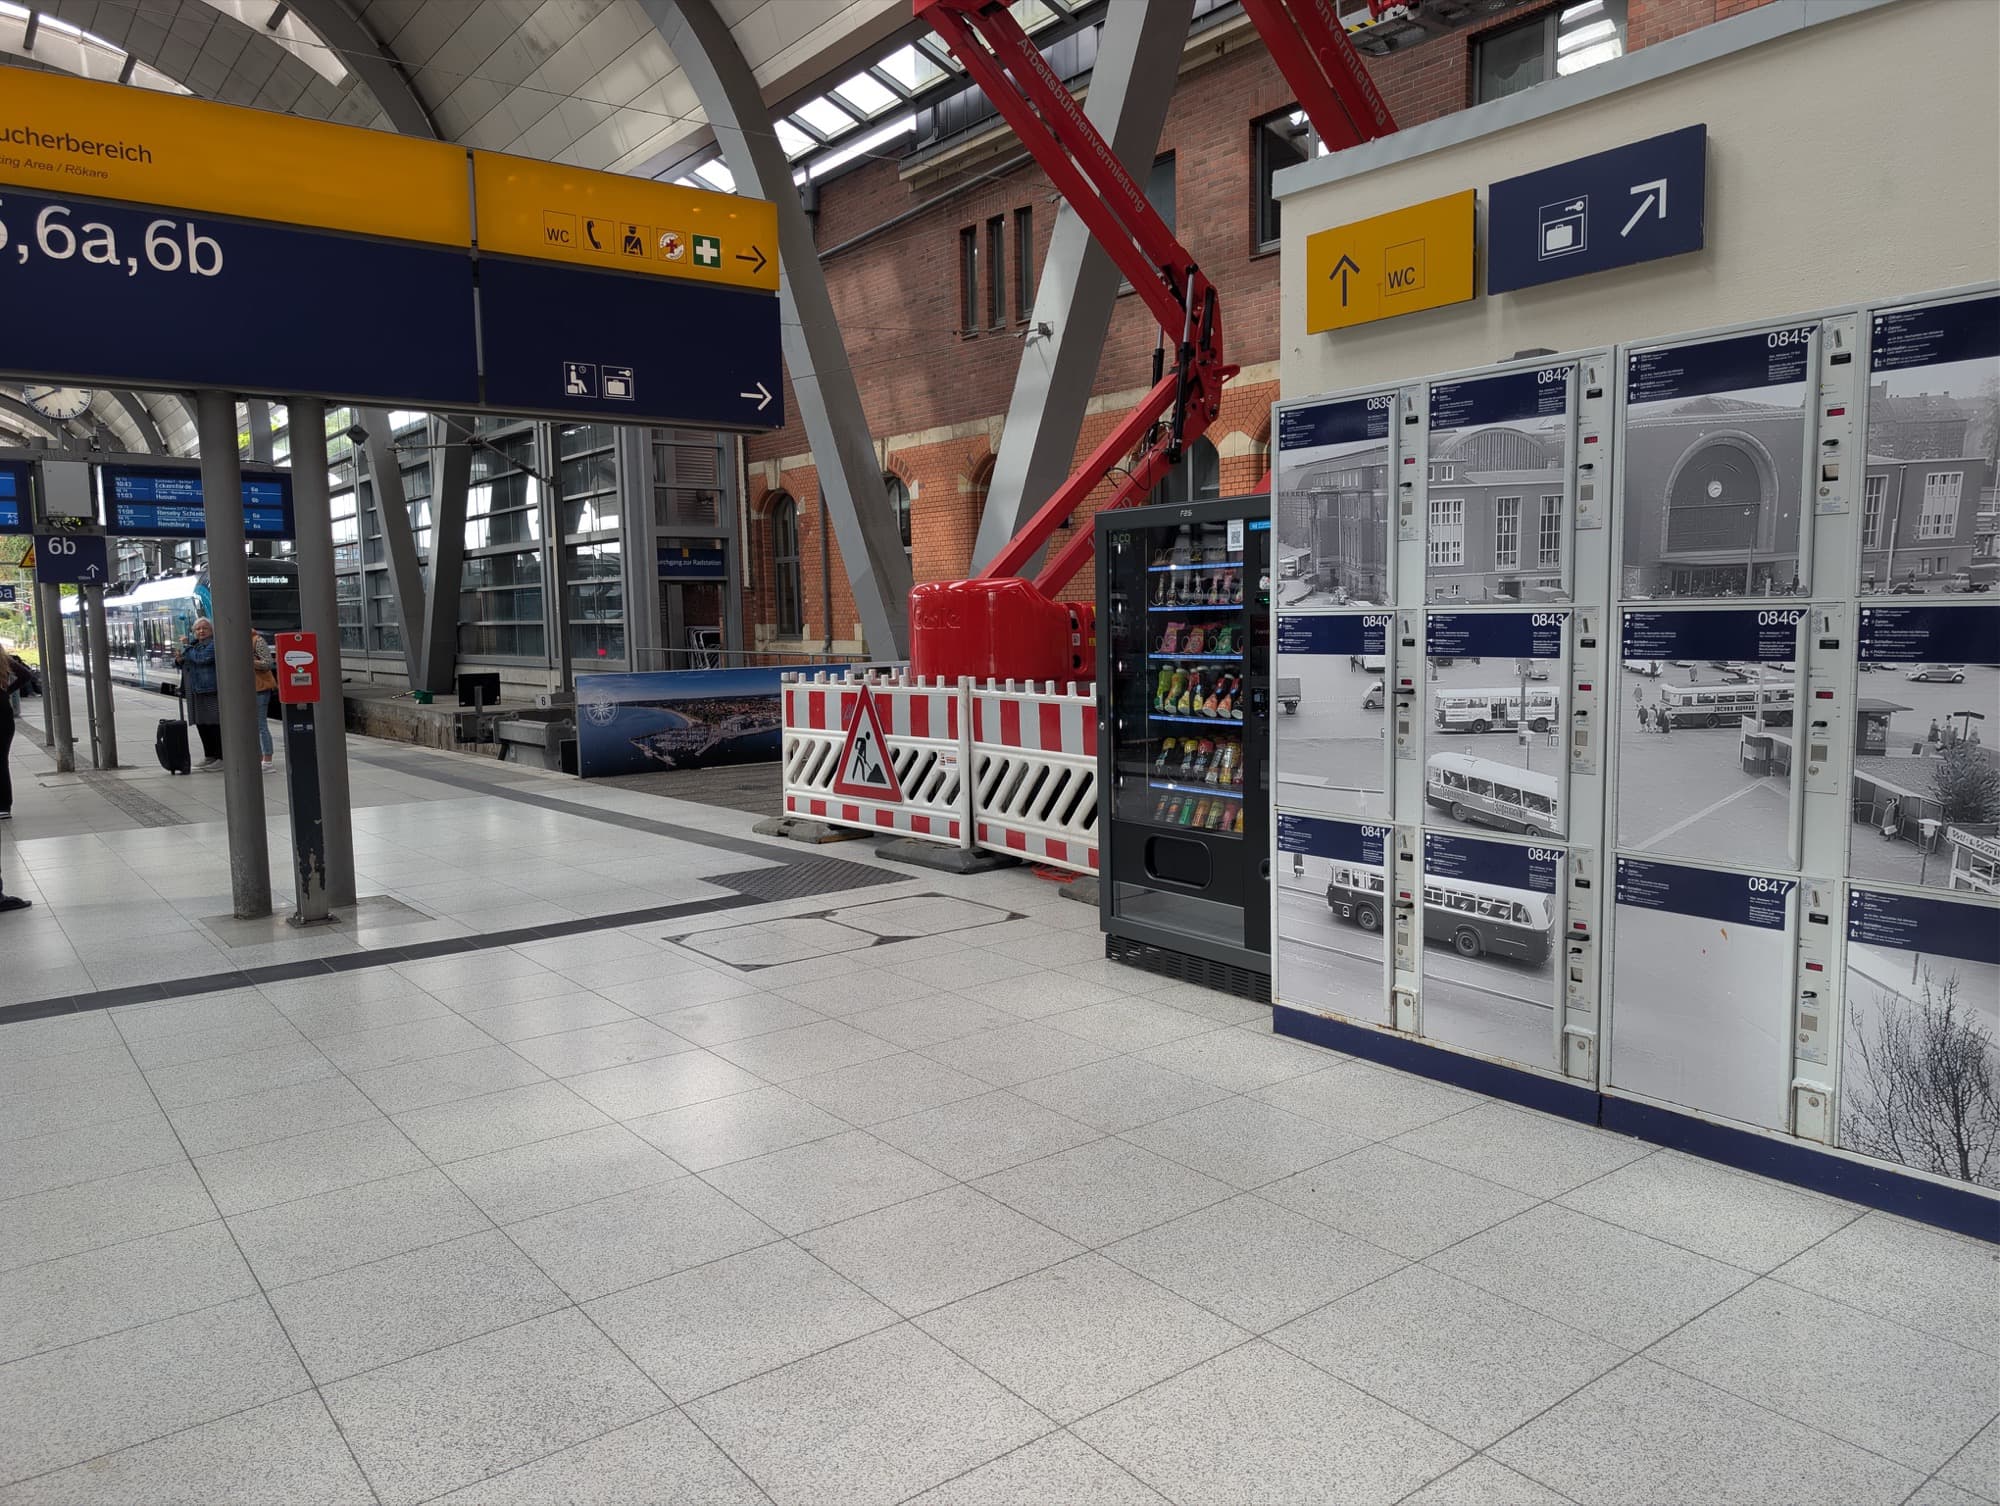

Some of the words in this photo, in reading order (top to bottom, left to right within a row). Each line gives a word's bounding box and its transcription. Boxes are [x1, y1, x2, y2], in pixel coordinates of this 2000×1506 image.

[24, 157, 53, 172] Area
[65, 164, 109, 179] Rökare
[0, 199, 223, 277] ,6a,6b
[546, 227, 570, 244] WC
[1387, 266, 1416, 289] WC
[1767, 328, 1811, 348] 0845
[1537, 367, 1570, 384] 0842
[1367, 395, 1393, 410] 0839
[48, 537, 76, 554] 6b
[0, 588, 13, 599] a
[1363, 615, 1389, 627] 0840
[1531, 613, 1564, 627] 0843
[1758, 610, 1800, 626] 0846
[1361, 825, 1386, 838] 0841
[1527, 847, 1559, 862] 0844
[1748, 877, 1789, 895] 0847
